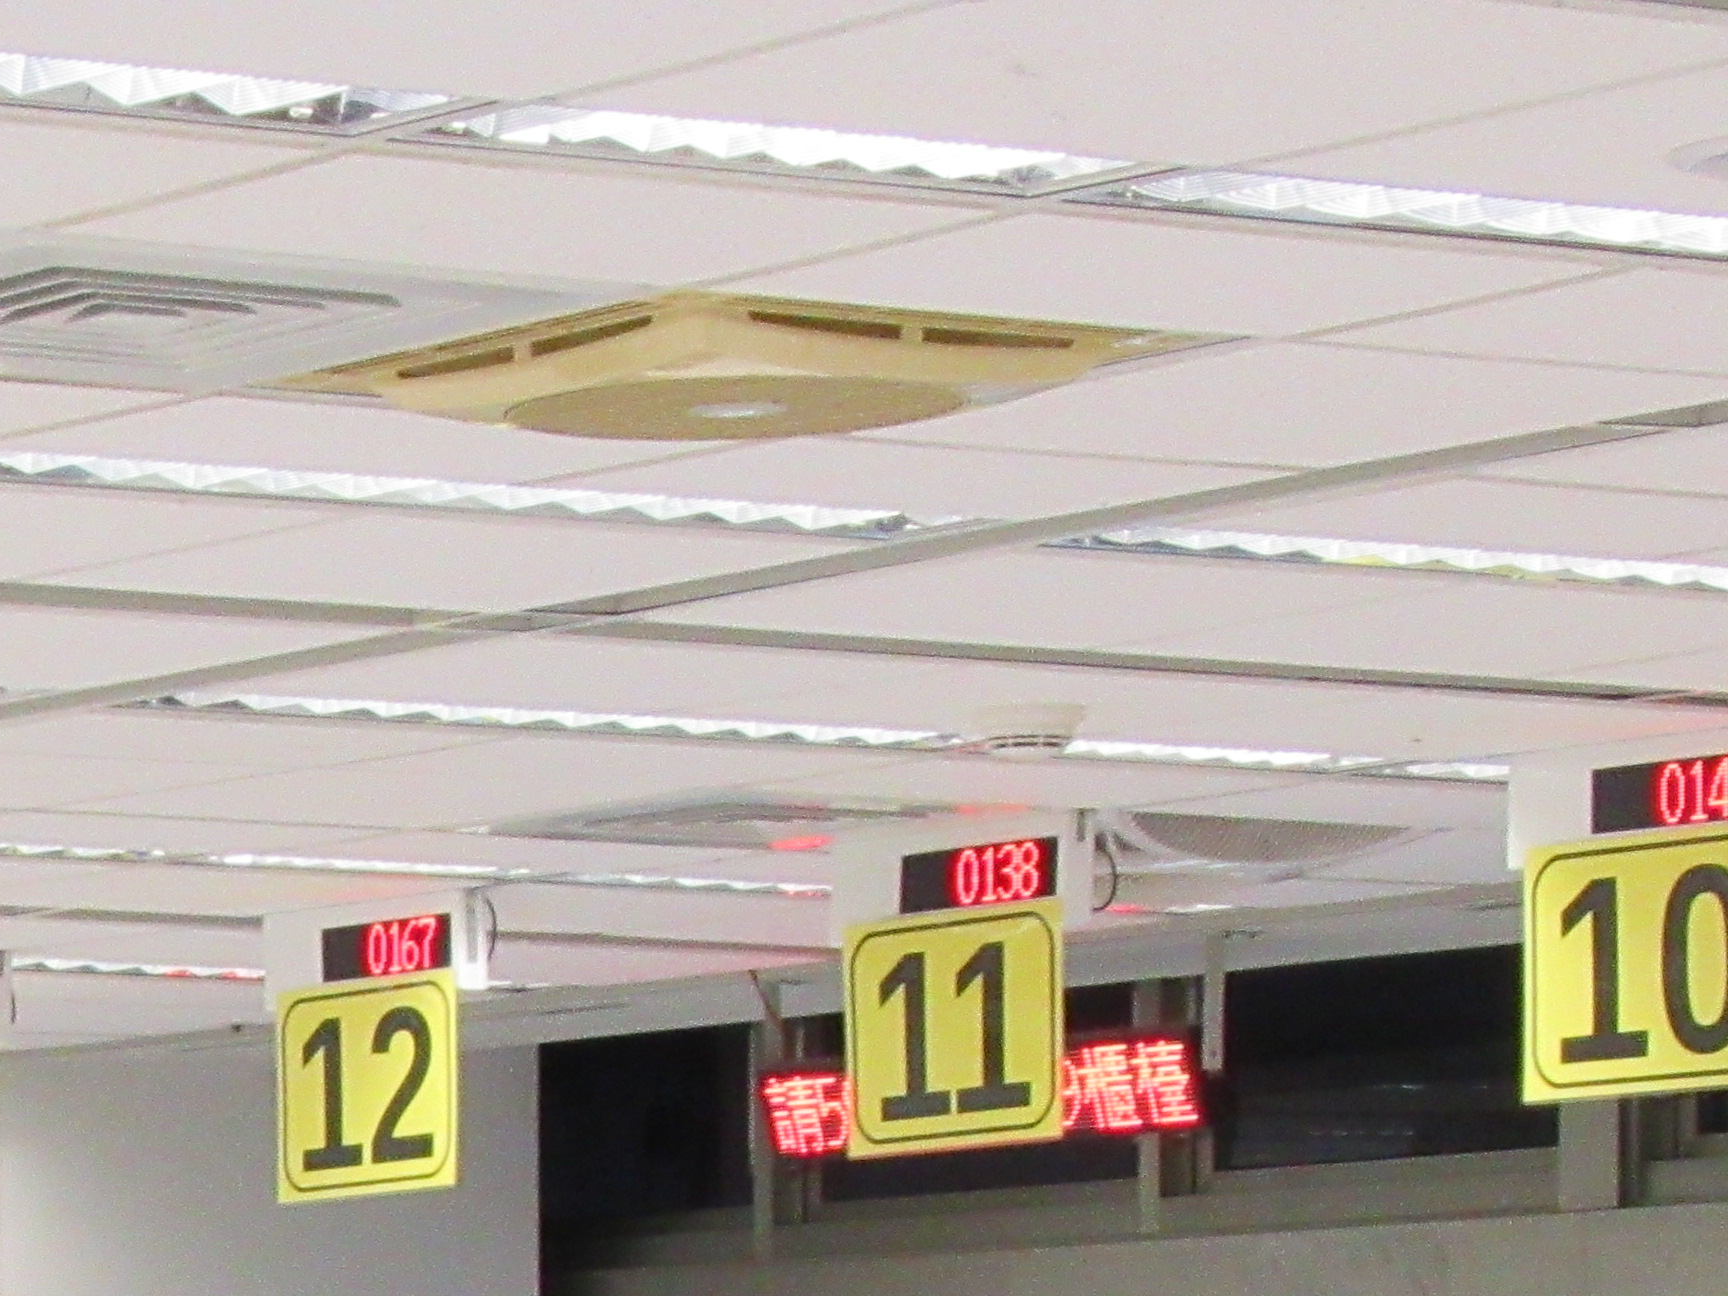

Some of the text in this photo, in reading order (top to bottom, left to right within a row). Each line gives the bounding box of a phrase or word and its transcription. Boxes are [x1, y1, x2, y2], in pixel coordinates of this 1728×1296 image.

[368, 916, 436, 974] 0167
[956, 841, 1040, 904] 0138
[878, 940, 1031, 1122] 11
[1559, 863, 1728, 1065] 10
[302, 1005, 434, 1172] 12
